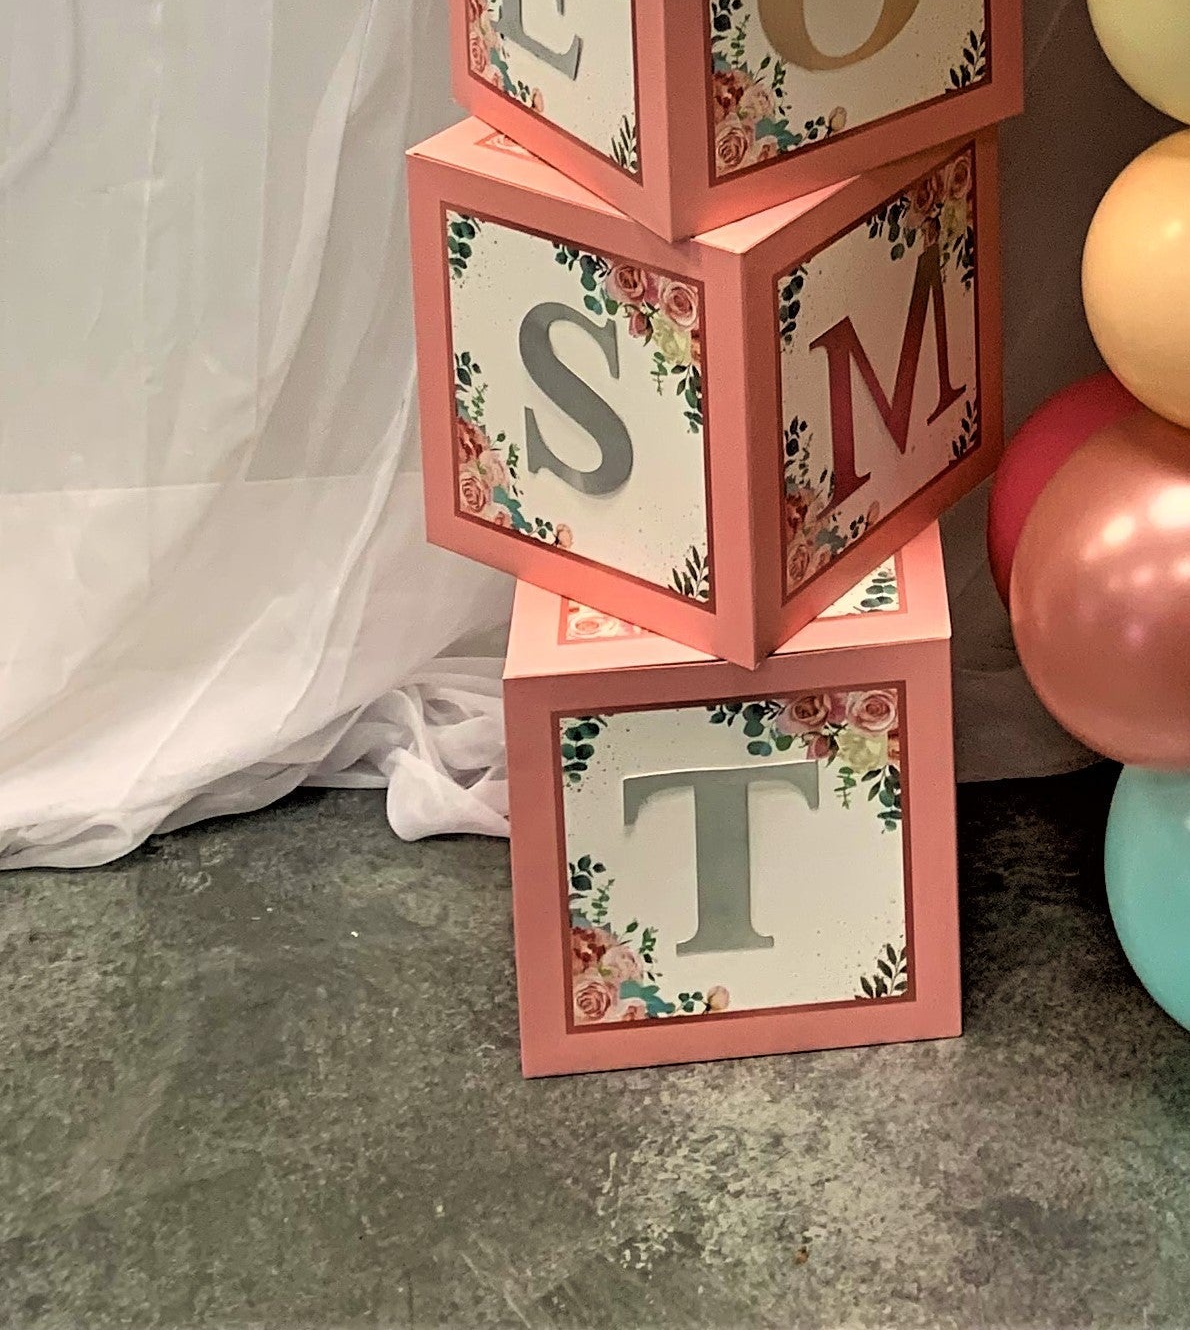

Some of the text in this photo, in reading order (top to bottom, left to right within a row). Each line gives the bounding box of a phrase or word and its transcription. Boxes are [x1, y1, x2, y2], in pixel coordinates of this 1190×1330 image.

[519, 301, 634, 496] S
[809, 243, 967, 521] M
[623, 760, 820, 957] T
